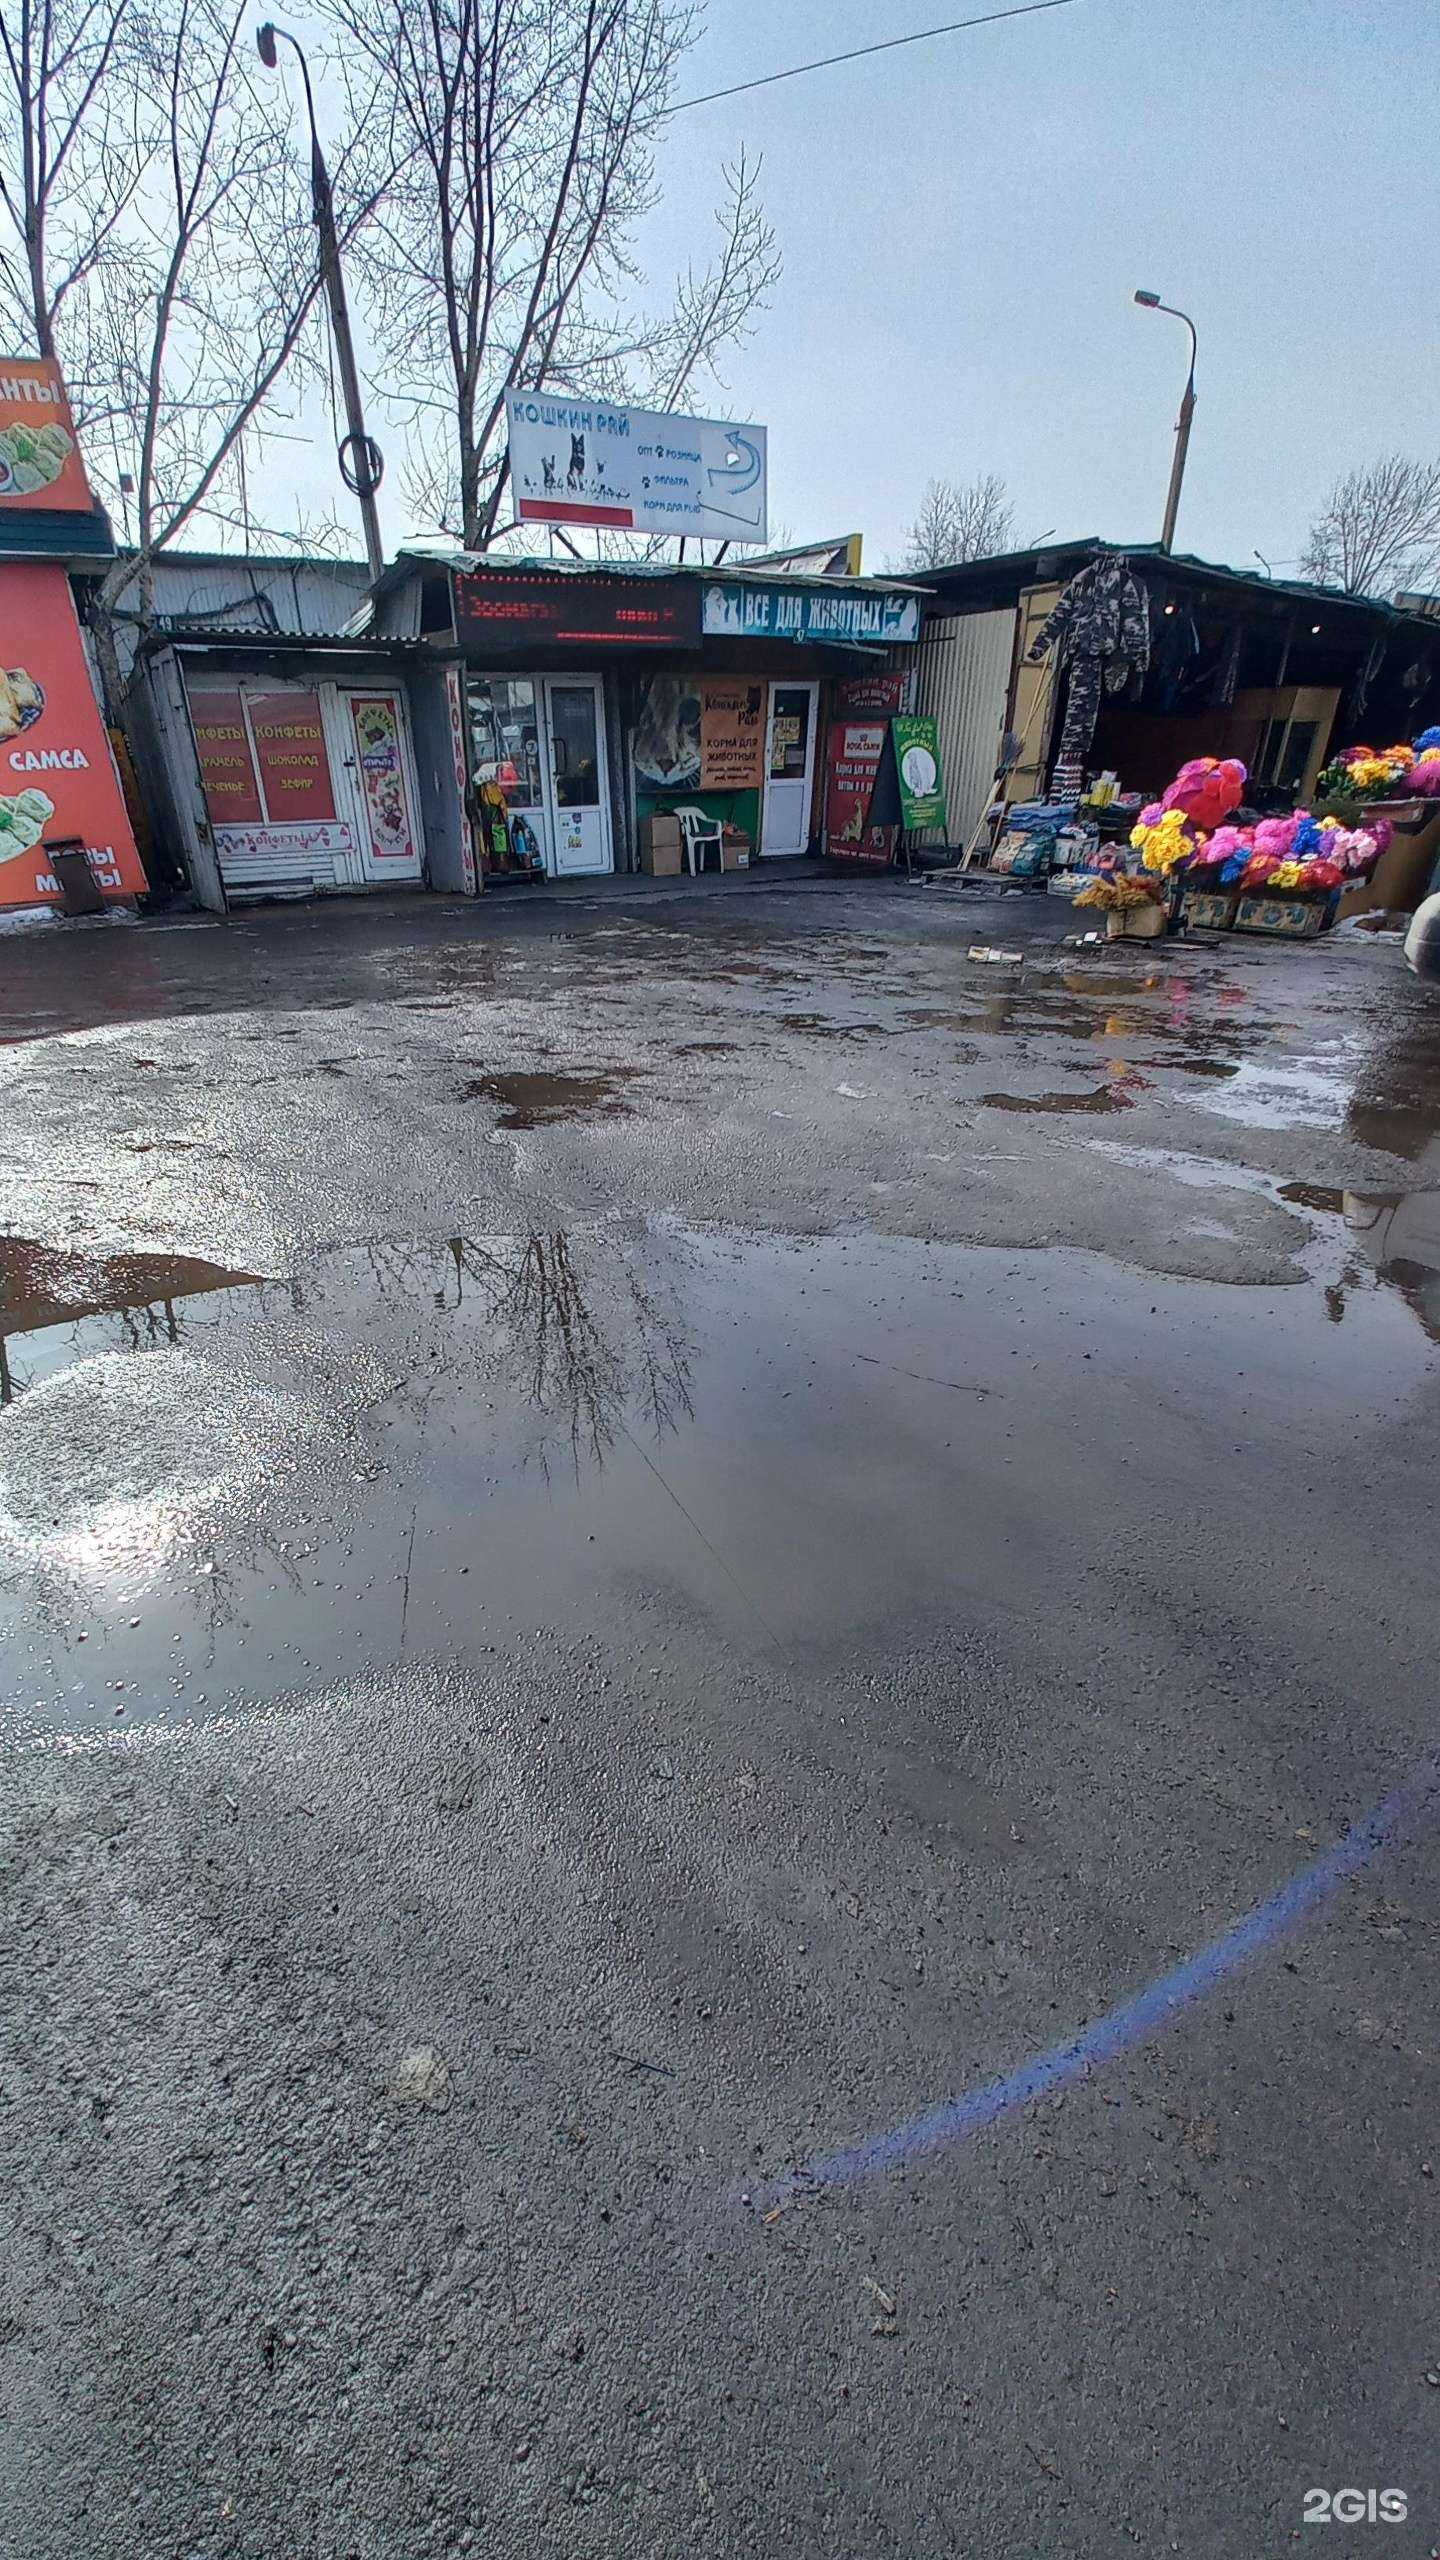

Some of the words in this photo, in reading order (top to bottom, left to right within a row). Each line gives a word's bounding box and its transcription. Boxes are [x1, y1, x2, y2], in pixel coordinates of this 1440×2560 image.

[0, 377, 61, 404] НТЫ
[513, 401, 593, 433] КОШКИН
[597, 412, 631, 437] РАЙ
[745, 594, 770, 628] ВСЕ
[775, 596, 804, 631] ДЛЯ
[807, 598, 882, 632] ЖИВОТНЫХ
[159, 616, 172, 631] 49
[196, 726, 245, 740] НФЕТЫ
[255, 725, 322, 739] КОНФЕТЫ
[707, 738, 737, 748] КОРМА
[9, 748, 90, 771] САМСА
[200, 757, 245, 769] РАМЕЛЬ
[707, 751, 757, 762] ЖИВОТНЫХ
